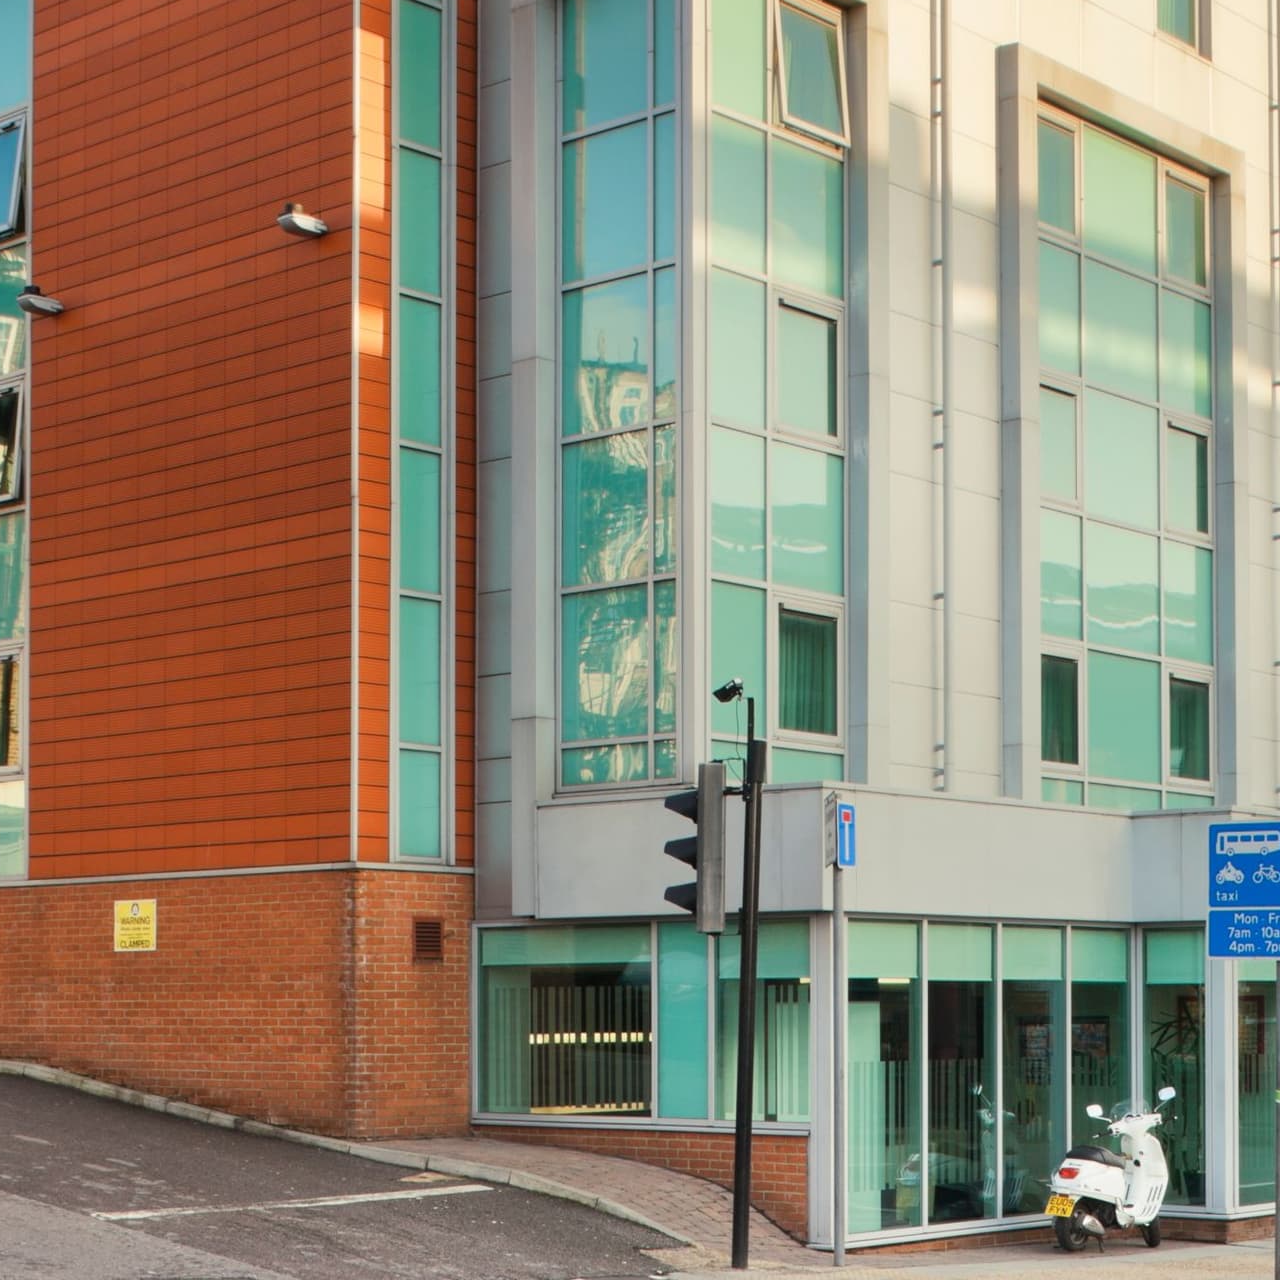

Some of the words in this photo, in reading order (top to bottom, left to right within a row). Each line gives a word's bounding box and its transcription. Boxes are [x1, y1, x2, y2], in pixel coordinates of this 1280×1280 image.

[1216, 889, 1239, 901] taxi
[1233, 912, 1258, 924] Mon
[1227, 926, 1251, 938] 7am
[1228, 940, 1255, 954] 4pm
